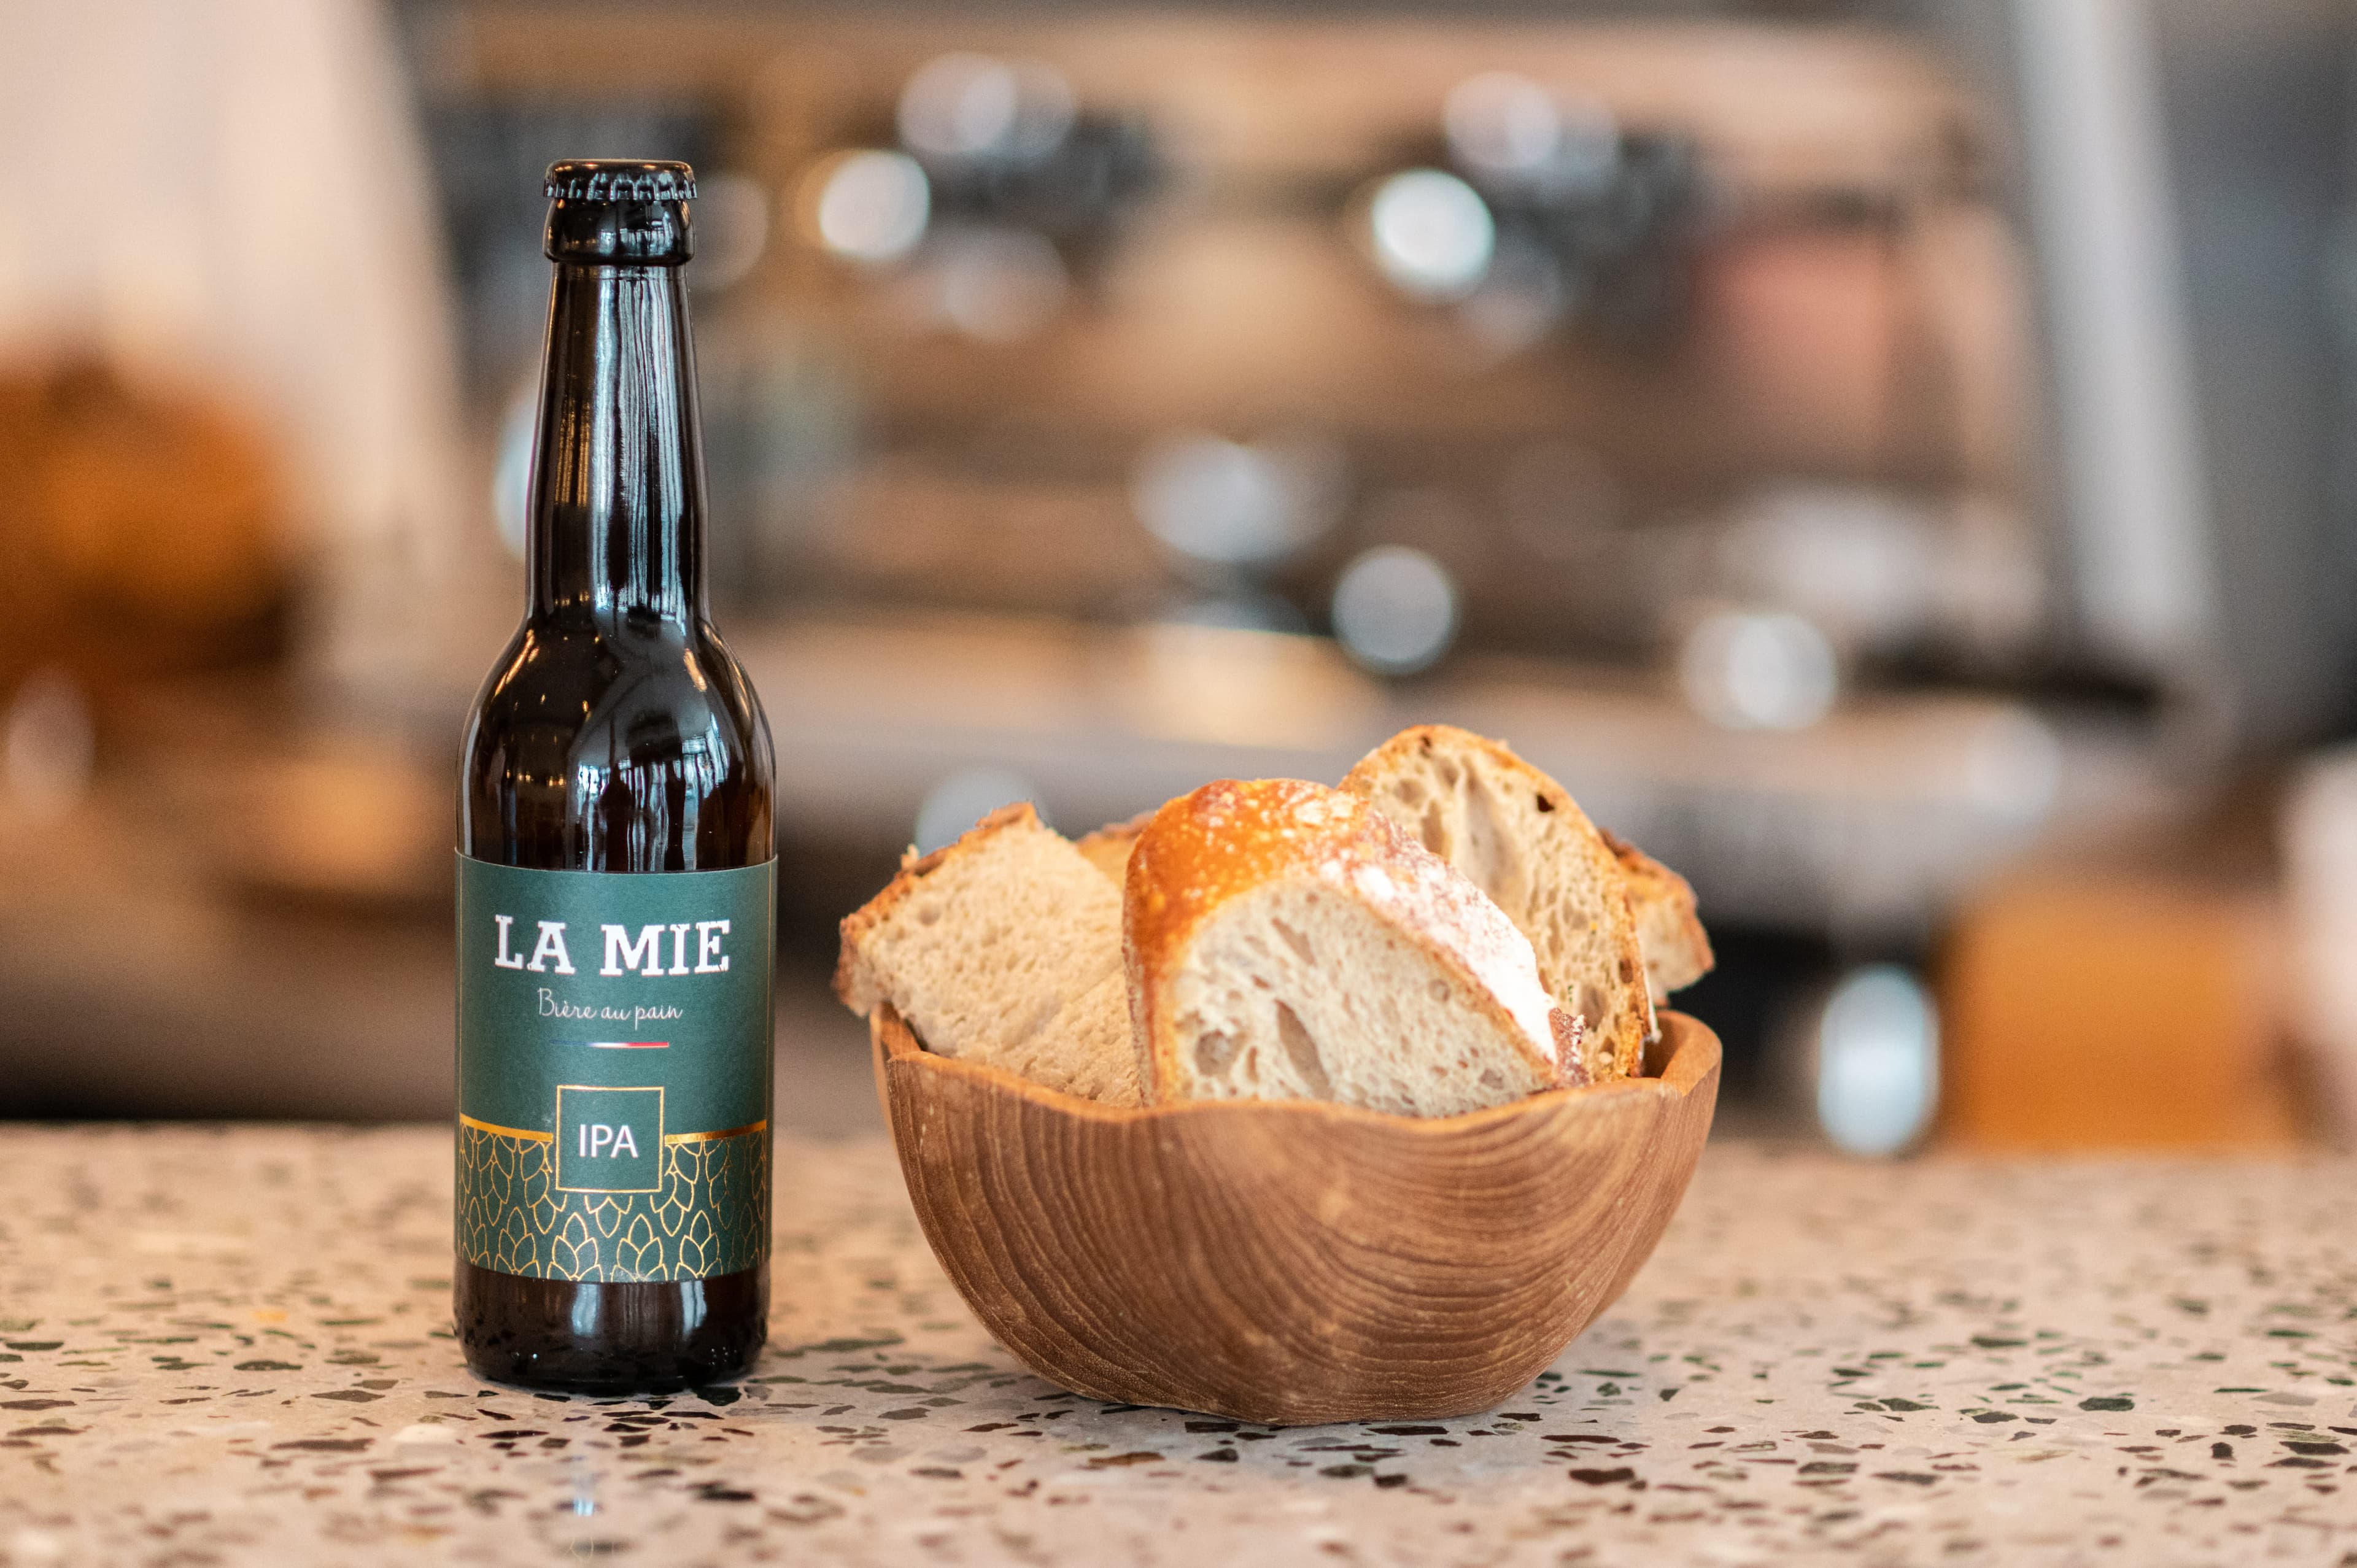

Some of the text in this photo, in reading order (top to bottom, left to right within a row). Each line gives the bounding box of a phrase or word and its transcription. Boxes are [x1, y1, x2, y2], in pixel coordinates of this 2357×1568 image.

[494, 914, 731, 977] LA MIE
[537, 987, 684, 1031] Bière au pain
[579, 1124, 639, 1159] IPA
